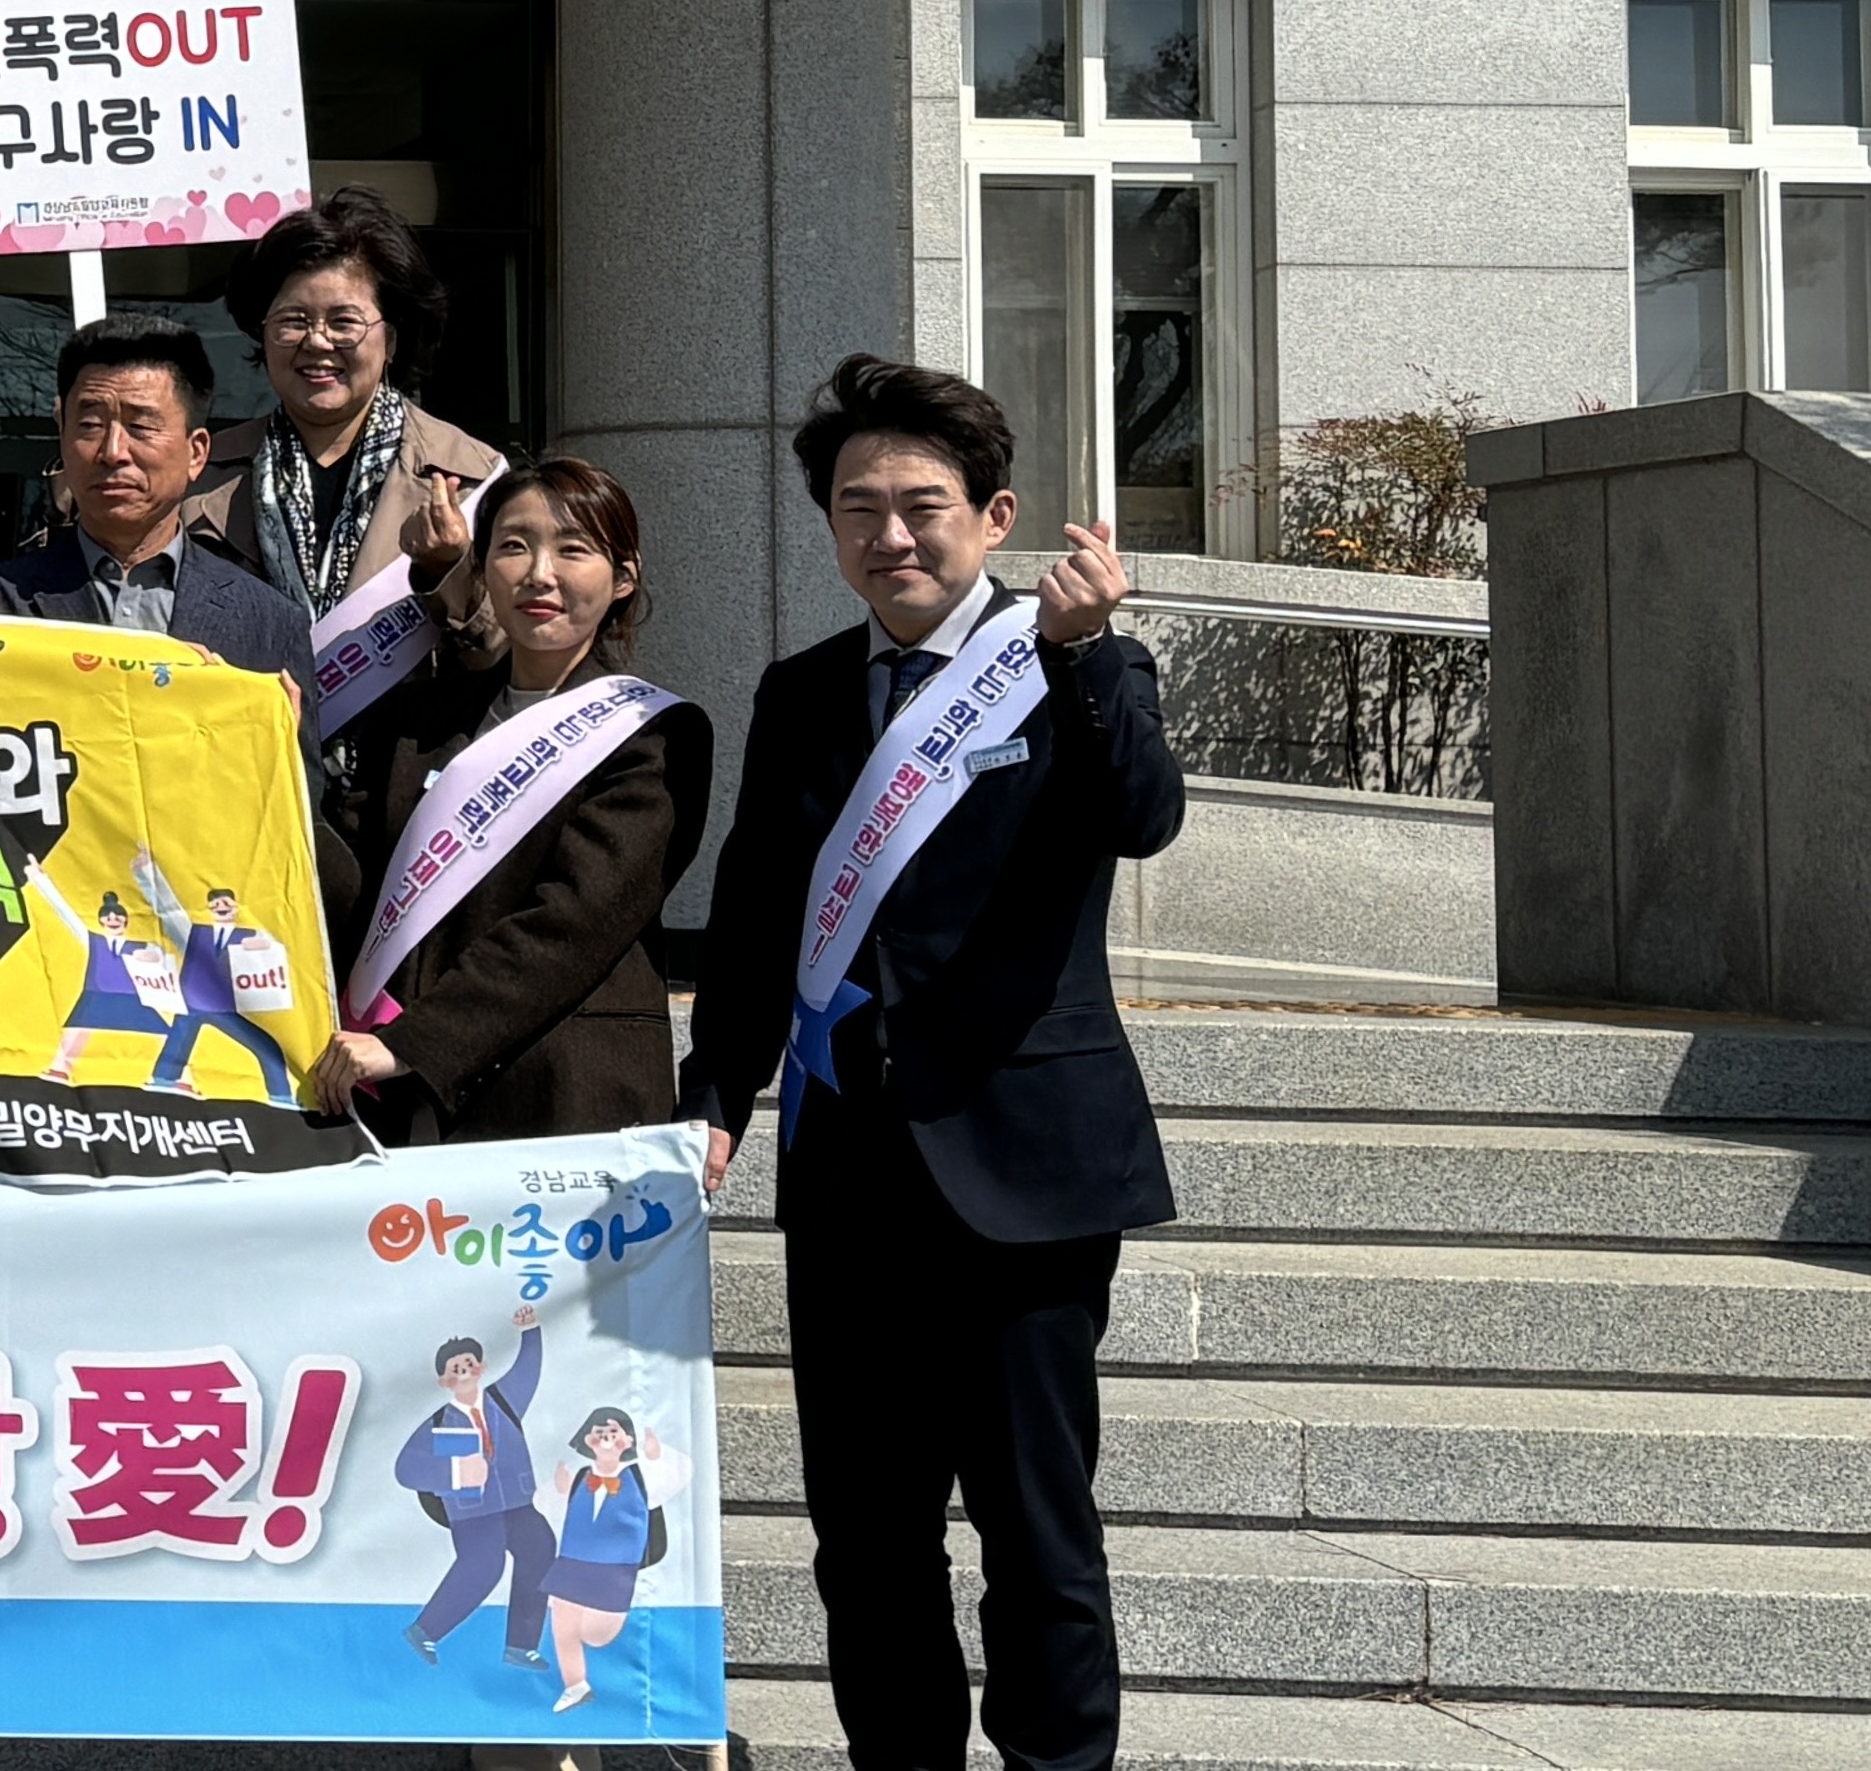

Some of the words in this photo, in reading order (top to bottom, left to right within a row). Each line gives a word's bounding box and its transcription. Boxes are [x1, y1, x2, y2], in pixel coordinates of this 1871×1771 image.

[181, 94, 240, 151] IN
[458, 737, 560, 846] 학교폭력,
[852, 763, 928, 865] 행복한
[135, 972, 177, 993] out!
[236, 966, 287, 990] out!
[518, 1170, 619, 1193] 경남교육
[368, 1198, 674, 1301] 아이좋아
[69, 1360, 347, 1548] 愛!
